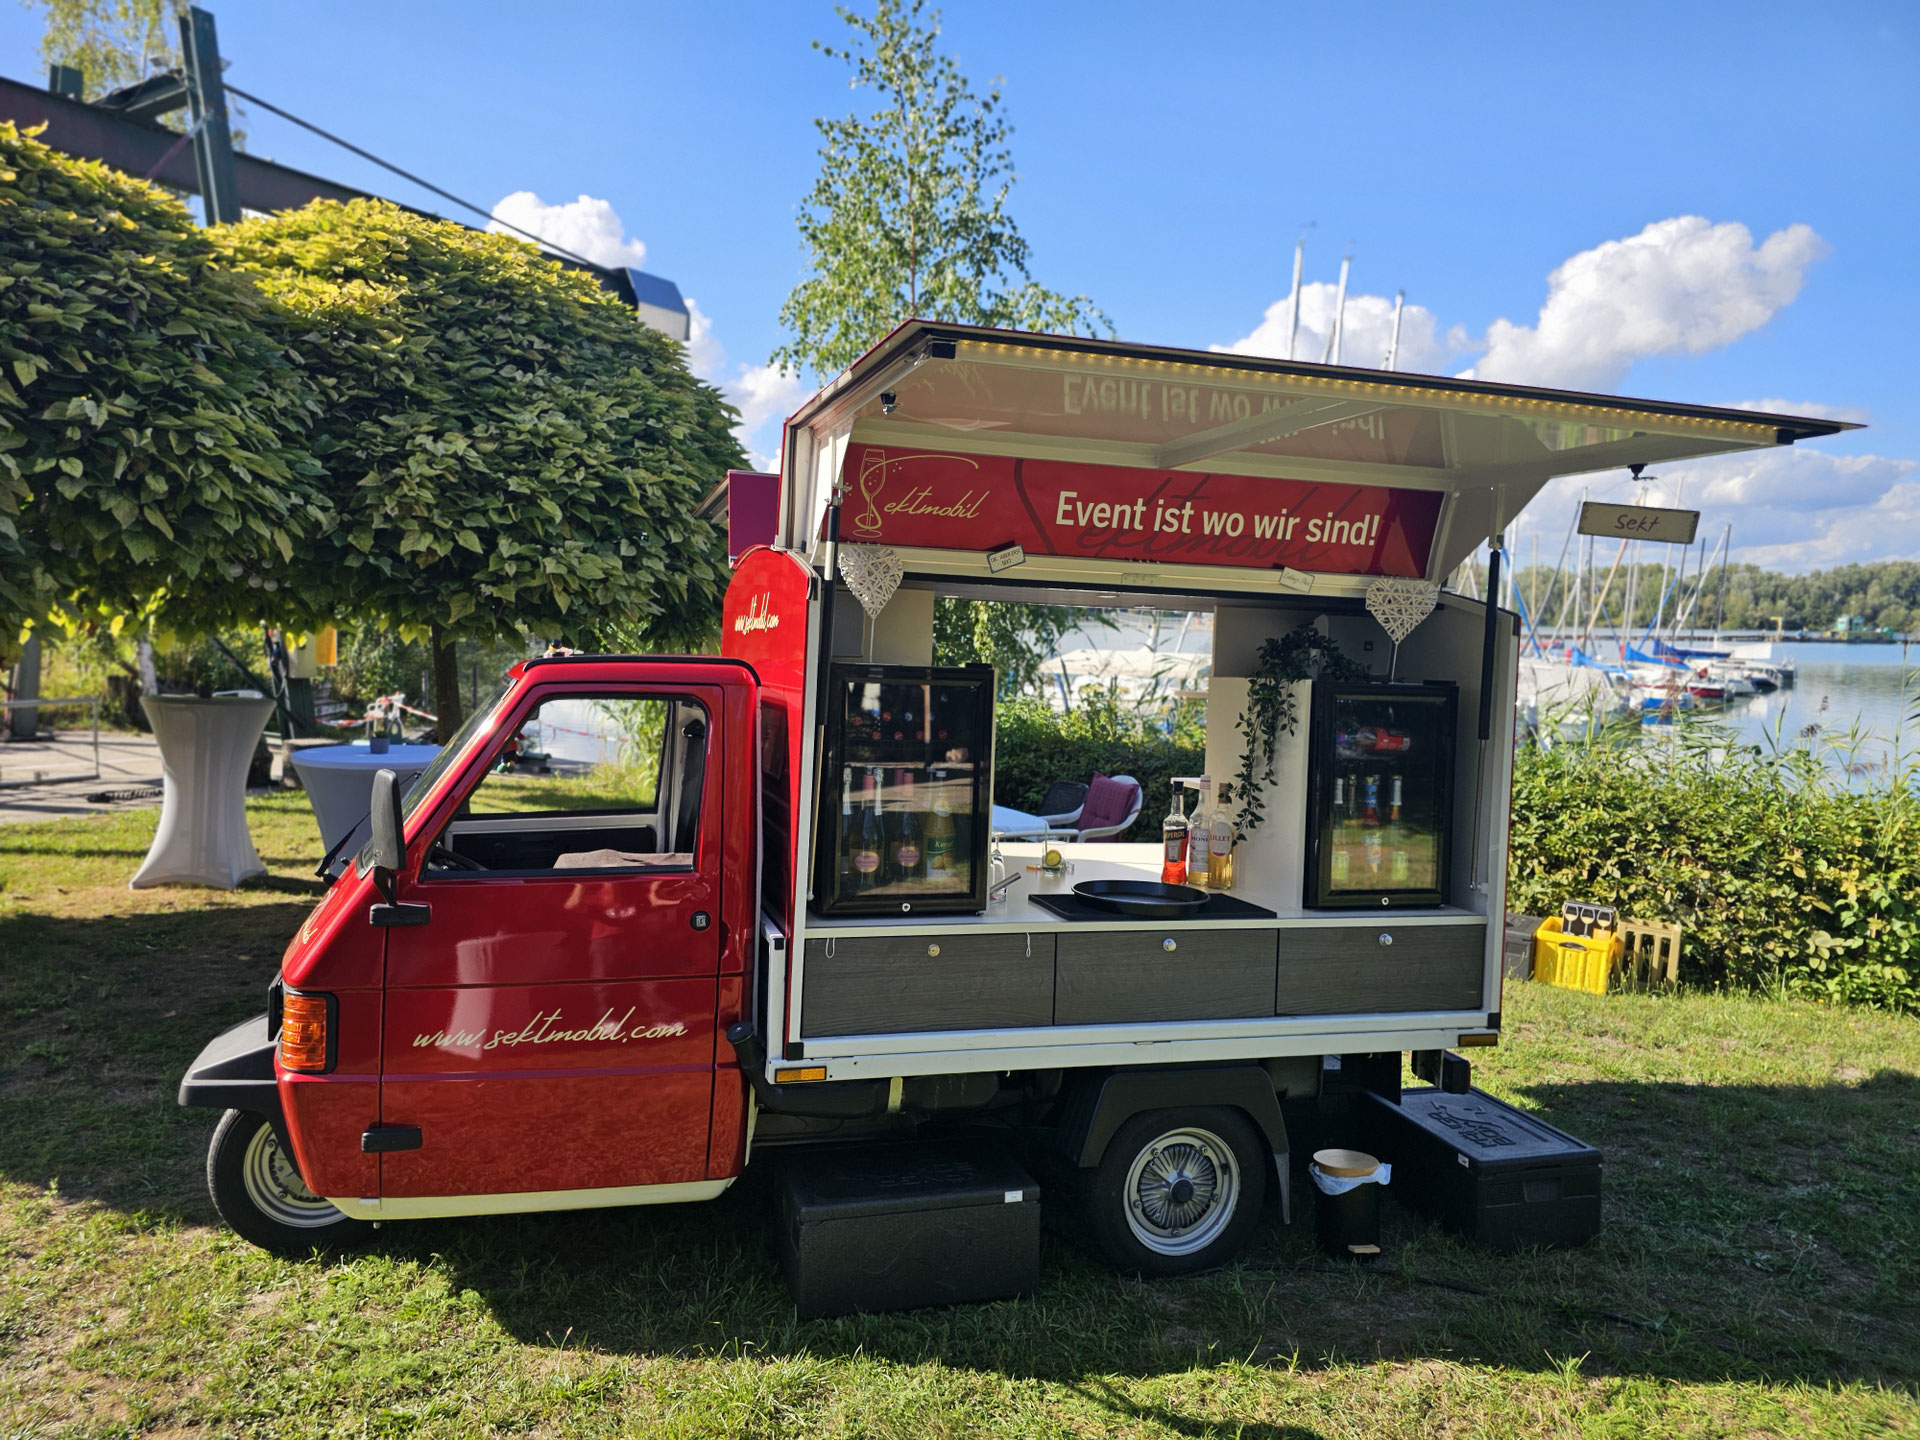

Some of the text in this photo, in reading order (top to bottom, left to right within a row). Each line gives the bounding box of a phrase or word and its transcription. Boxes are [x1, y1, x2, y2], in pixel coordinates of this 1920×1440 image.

[1055, 490, 1380, 546] Event ist wo wir sind!
[1614, 514, 1661, 533] Sekt
[412, 1006, 689, 1050] www.sektmobil.com
